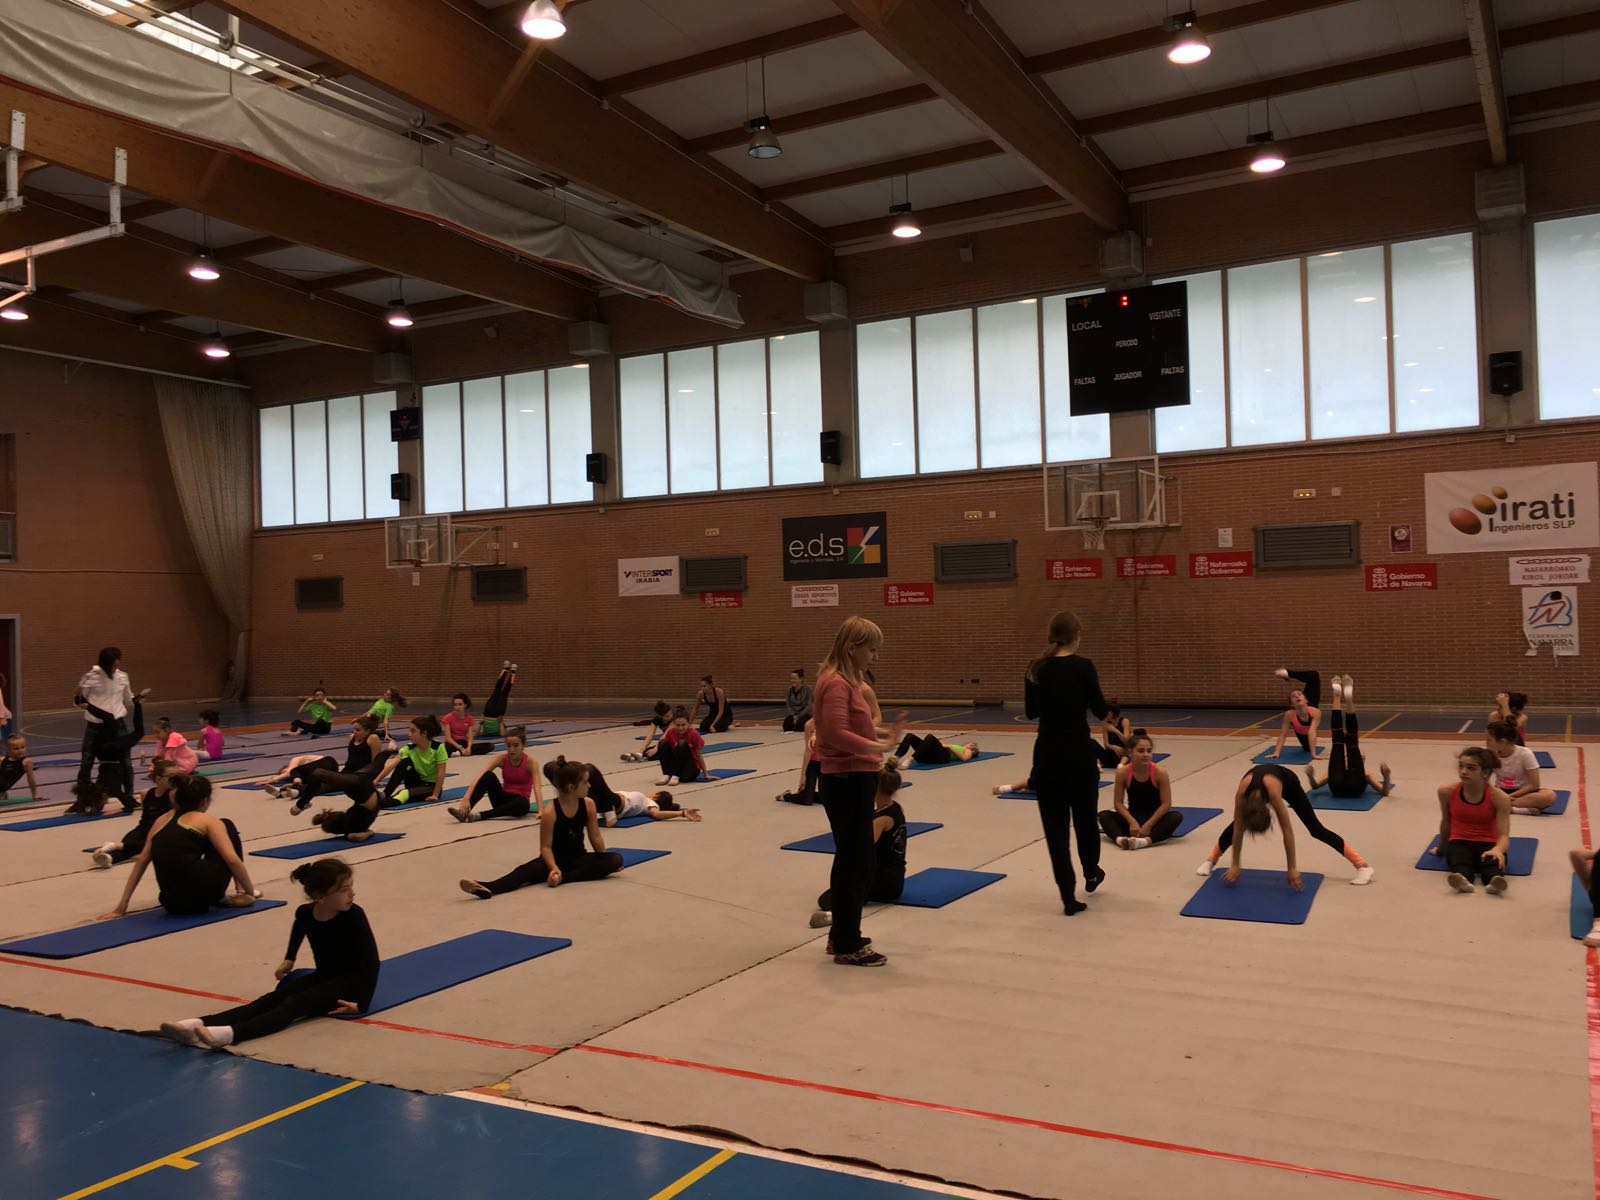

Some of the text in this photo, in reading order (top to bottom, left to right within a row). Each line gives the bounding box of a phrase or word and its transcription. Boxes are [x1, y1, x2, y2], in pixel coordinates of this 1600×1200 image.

[1149, 309, 1182, 320] VISITANTE
[1072, 320, 1102, 331] LOCAL
[1115, 338, 1138, 348] PERIODO
[1161, 366, 1185, 375] FALTAS
[1113, 371, 1143, 381] JUGADOR
[1074, 377, 1096, 386] FALTAS
[1500, 492, 1575, 521] irati
[1489, 518, 1576, 533] Ingenieros SLP
[631, 569, 673, 578] INTERSPORT
